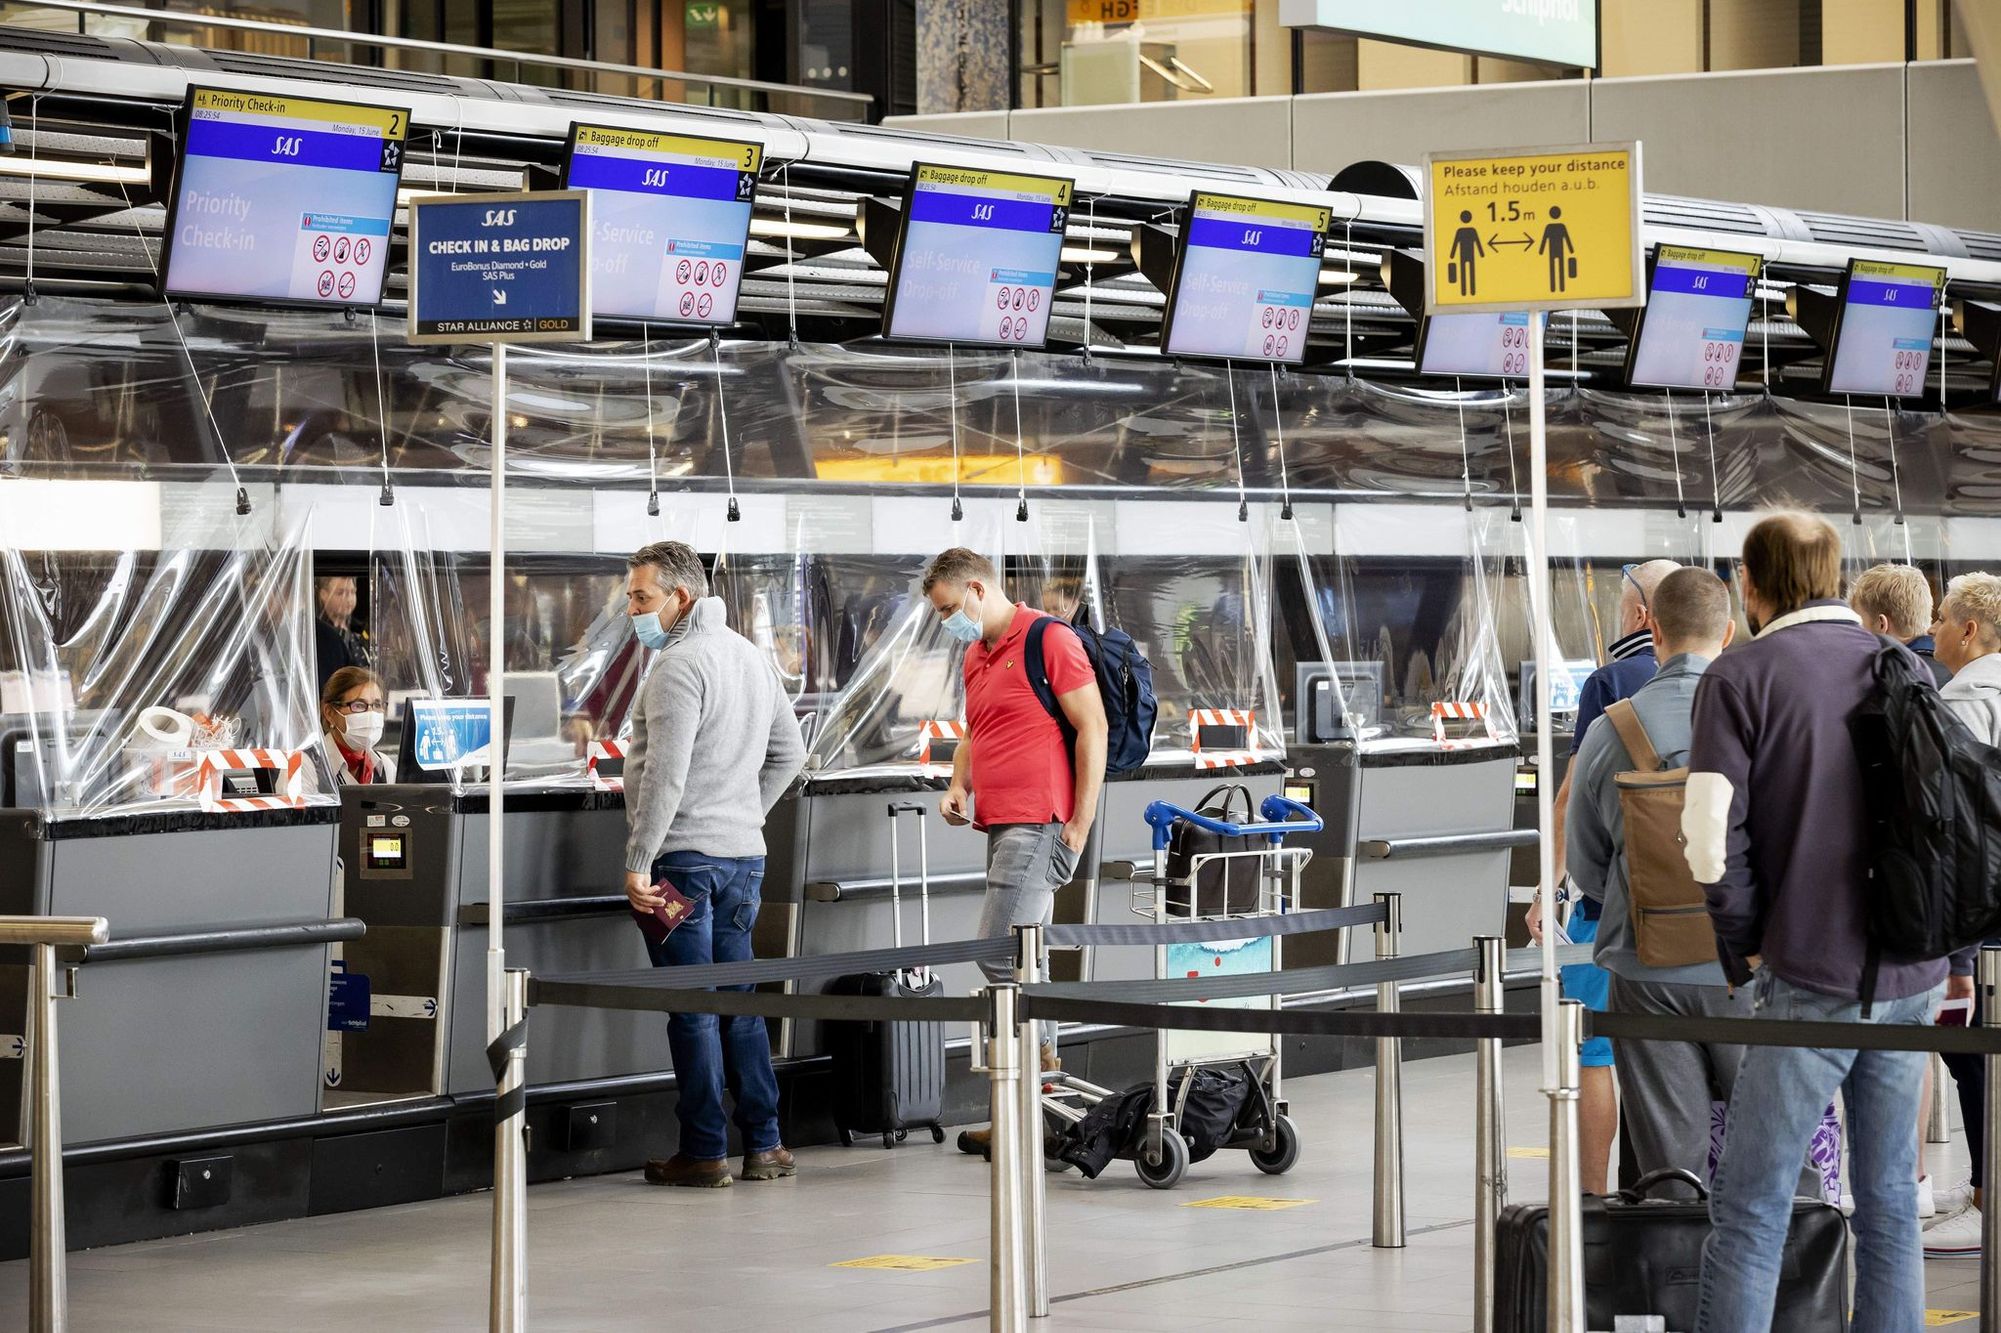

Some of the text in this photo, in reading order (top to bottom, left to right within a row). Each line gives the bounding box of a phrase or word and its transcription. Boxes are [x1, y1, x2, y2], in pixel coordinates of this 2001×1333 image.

[211, 94, 286, 113] Priority Check-in
[194, 110, 221, 119] 08:25:54
[359, 126, 366, 135] 15
[366, 128, 380, 136] June
[389, 114, 399, 135] 2
[271, 136, 303, 156] SAS
[591, 131, 660, 149] Baggage drop off
[743, 147, 754, 168] 3
[641, 168, 669, 187] SAS
[1443, 159, 1626, 178] Please keep your distance
[930, 169, 989, 187] Baggage drop off
[1444, 177, 1600, 197] Afstand houden a.u.b.
[1057, 184, 1067, 202] 4
[186, 190, 252, 222] Priority
[971, 203, 995, 221] SAS
[1207, 197, 1257, 213] Baggage drop off
[1487, 200, 1536, 222] 1.5 m
[481, 209, 517, 227] SAS
[1317, 211, 1326, 229] 5
[181, 224, 256, 251] Check-in
[429, 237, 571, 254] CHECK IN & BAG DROP
[1241, 229, 1263, 246] SAS
[451, 259, 547, 272] EuroBonus Diamond Gold
[1750, 258, 1758, 273] 7
[482, 270, 515, 281] SAS Plus
[1692, 275, 1709, 290] SAS
[1935, 271, 1942, 286] 8
[1883, 288, 1898, 301] SAS
[437, 320, 519, 332] STAR ALLIANCE
[539, 319, 569, 330] GOLD
